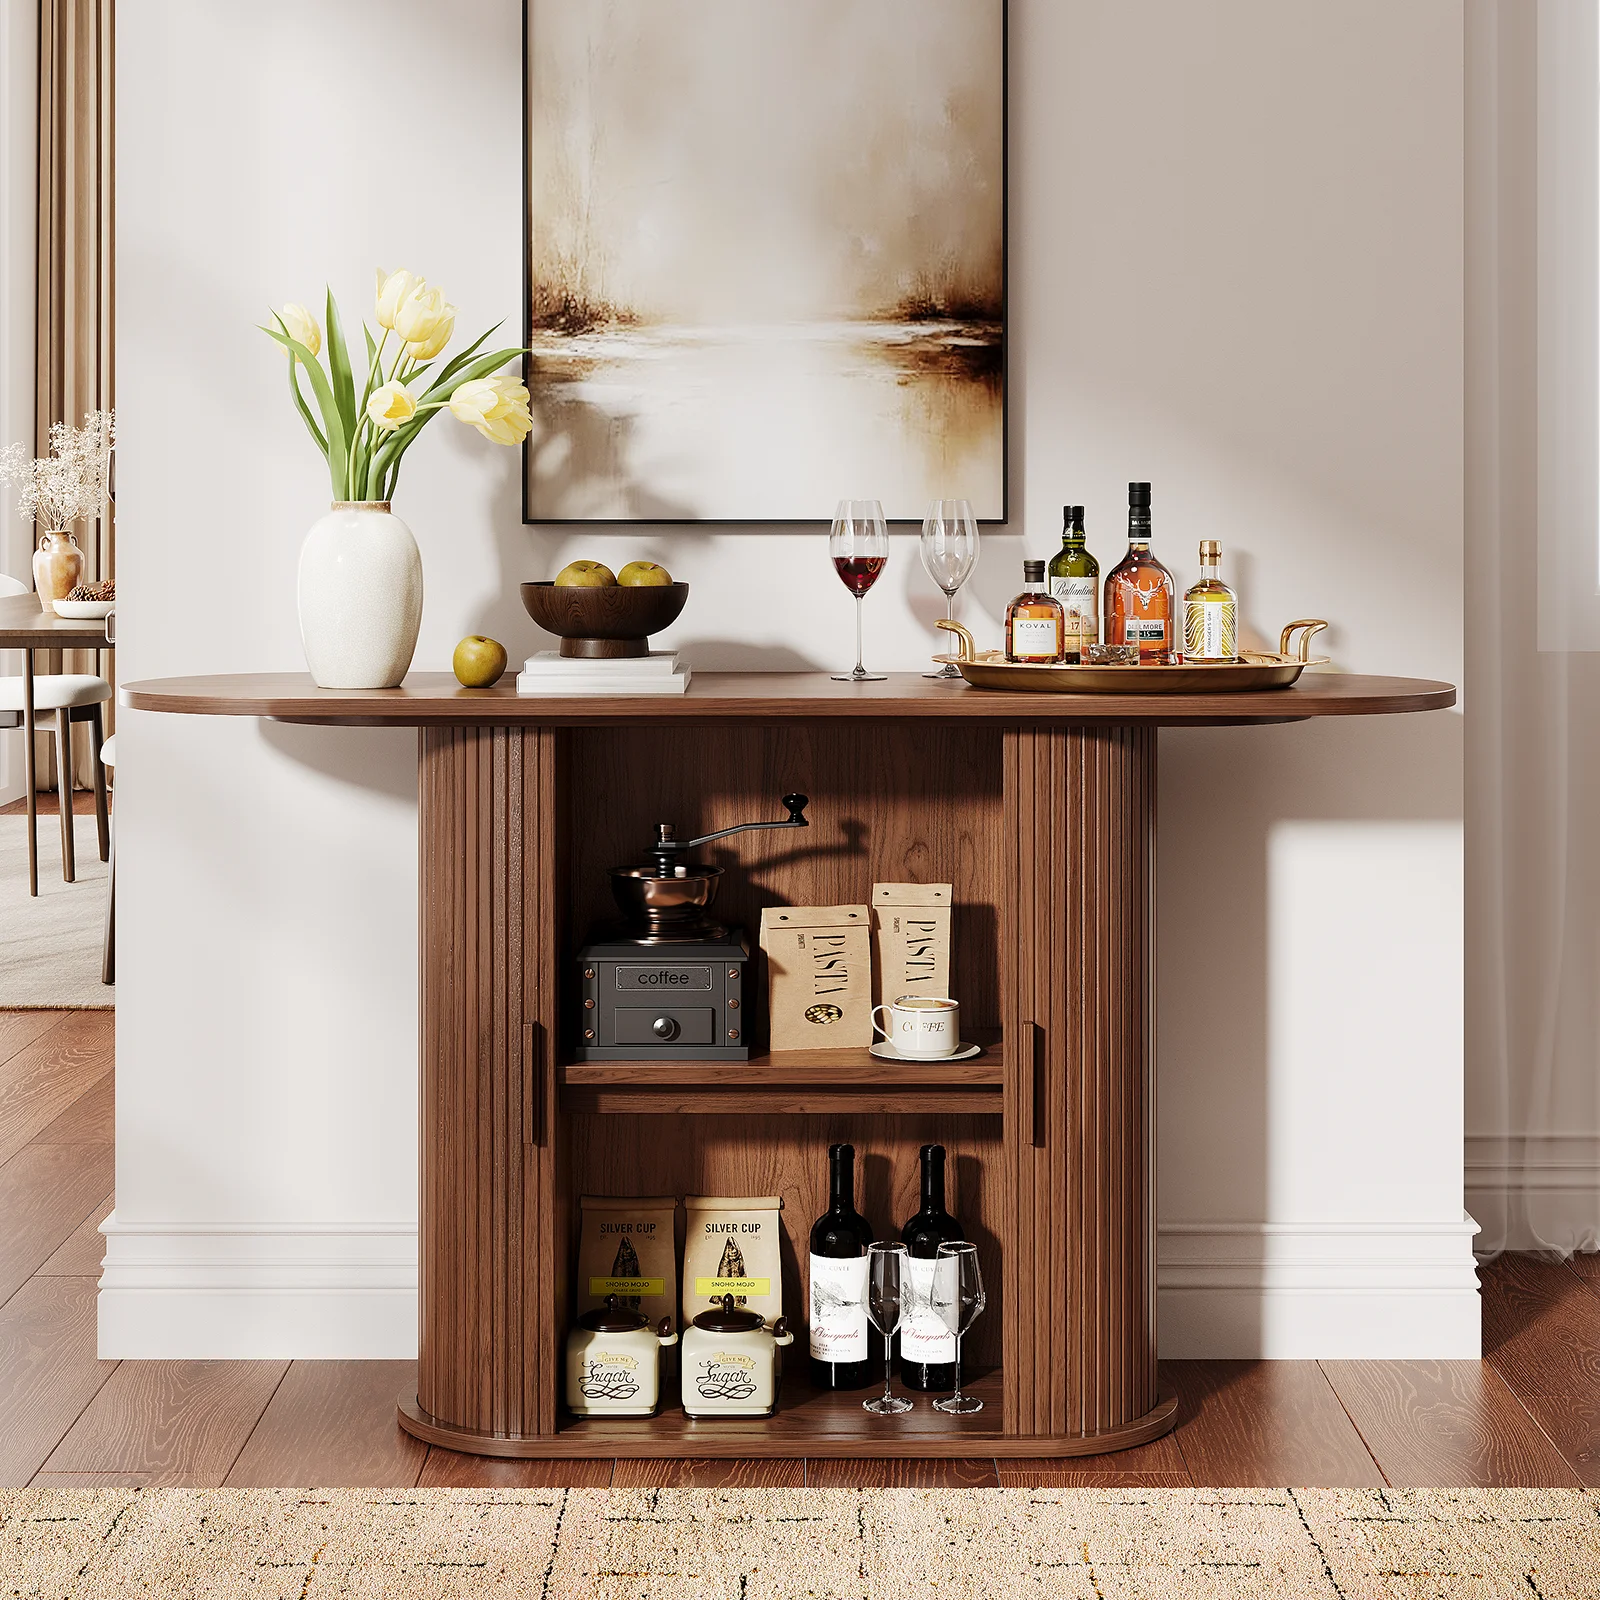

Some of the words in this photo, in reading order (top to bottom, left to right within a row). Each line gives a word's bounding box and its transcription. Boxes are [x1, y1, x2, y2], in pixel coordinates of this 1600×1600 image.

[1071, 621, 1080, 630] 17
[906, 920, 937, 983] PASTA
[812, 935, 848, 995] PASTA
[638, 971, 689, 985] coffee
[600, 1223, 633, 1233] SILVER
[636, 1223, 656, 1233] CUP
[705, 1223, 738, 1233] SILVER
[741, 1223, 761, 1233] CUP
[578, 1360, 636, 1387] Sugar
[696, 1360, 753, 1387] Sugar
